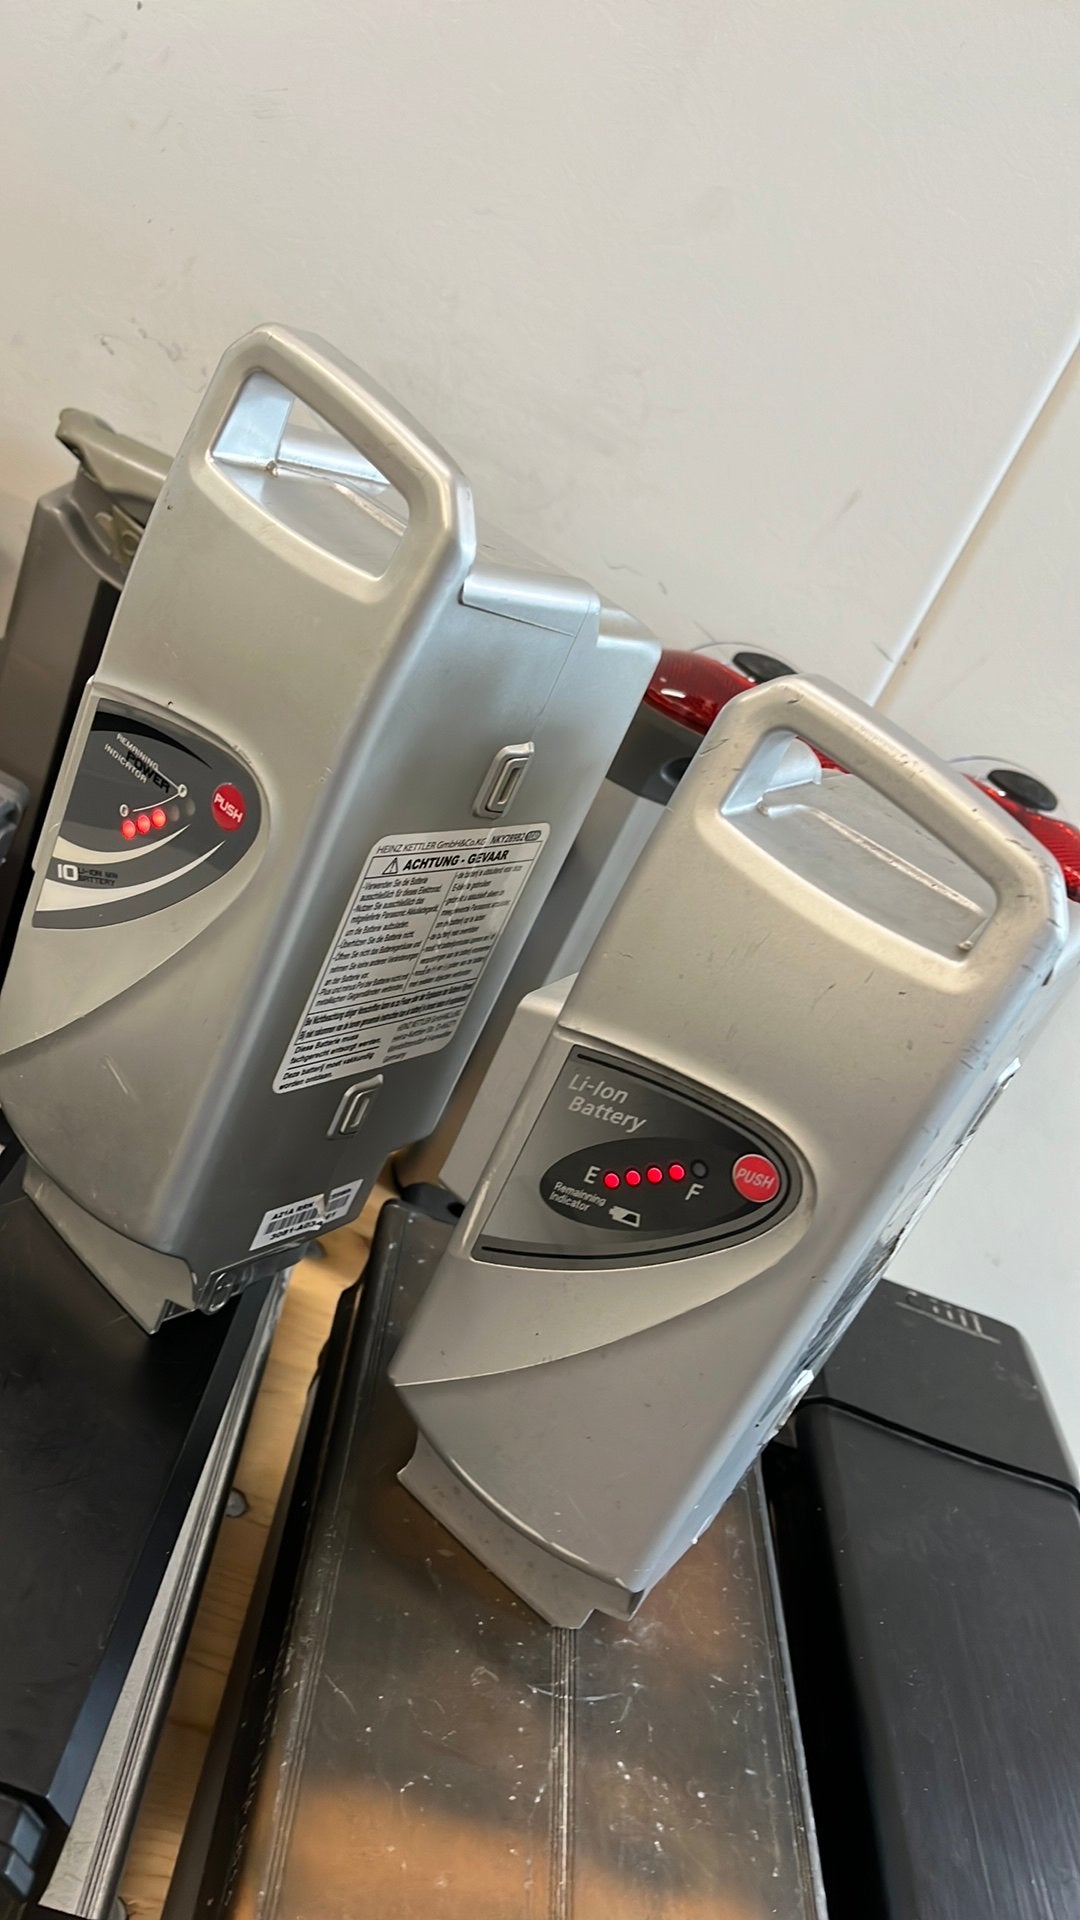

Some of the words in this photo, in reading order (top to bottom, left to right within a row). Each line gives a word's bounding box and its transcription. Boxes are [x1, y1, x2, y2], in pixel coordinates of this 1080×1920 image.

[105, 744, 147, 783] INDICATOR
[126, 751, 170, 793] POWER
[214, 792, 243, 822] PUSH
[376, 845, 403, 854] HEINZ
[403, 842, 436, 852] KETTLER
[403, 856, 460, 871] ACHTUNG
[468, 850, 509, 864] GEVAAR
[568, 1074, 629, 1104] Li-Ion
[568, 1095, 647, 1134] Battery
[584, 1166, 601, 1184] E
[736, 1168, 775, 1190] PUSH
[685, 1183, 704, 1201] F
